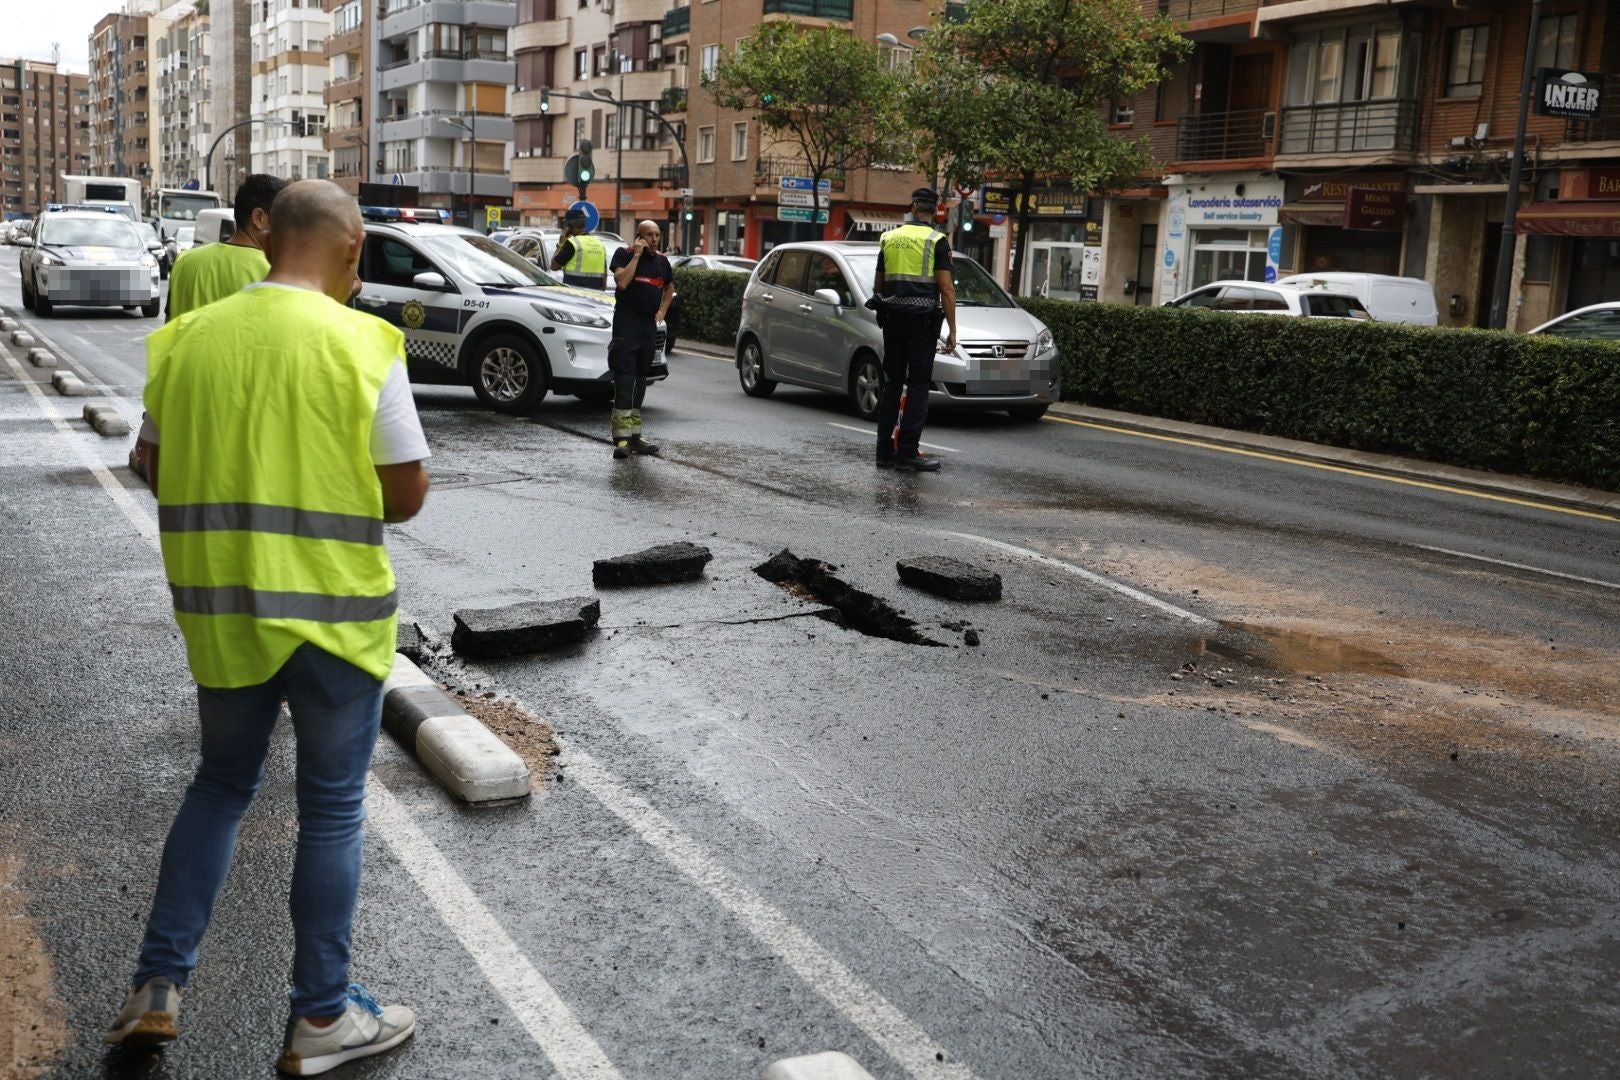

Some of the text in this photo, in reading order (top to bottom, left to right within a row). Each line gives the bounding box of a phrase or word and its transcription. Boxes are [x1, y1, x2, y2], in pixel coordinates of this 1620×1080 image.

[1544, 84, 1599, 107] INTER
[1546, 100, 1597, 111] PELUQUEROS
[1188, 196, 1281, 208] Lavandería autoservicio
[1216, 212, 1239, 220] service
[856, 222, 867, 232] LA
[463, 299, 490, 309] D5-01
